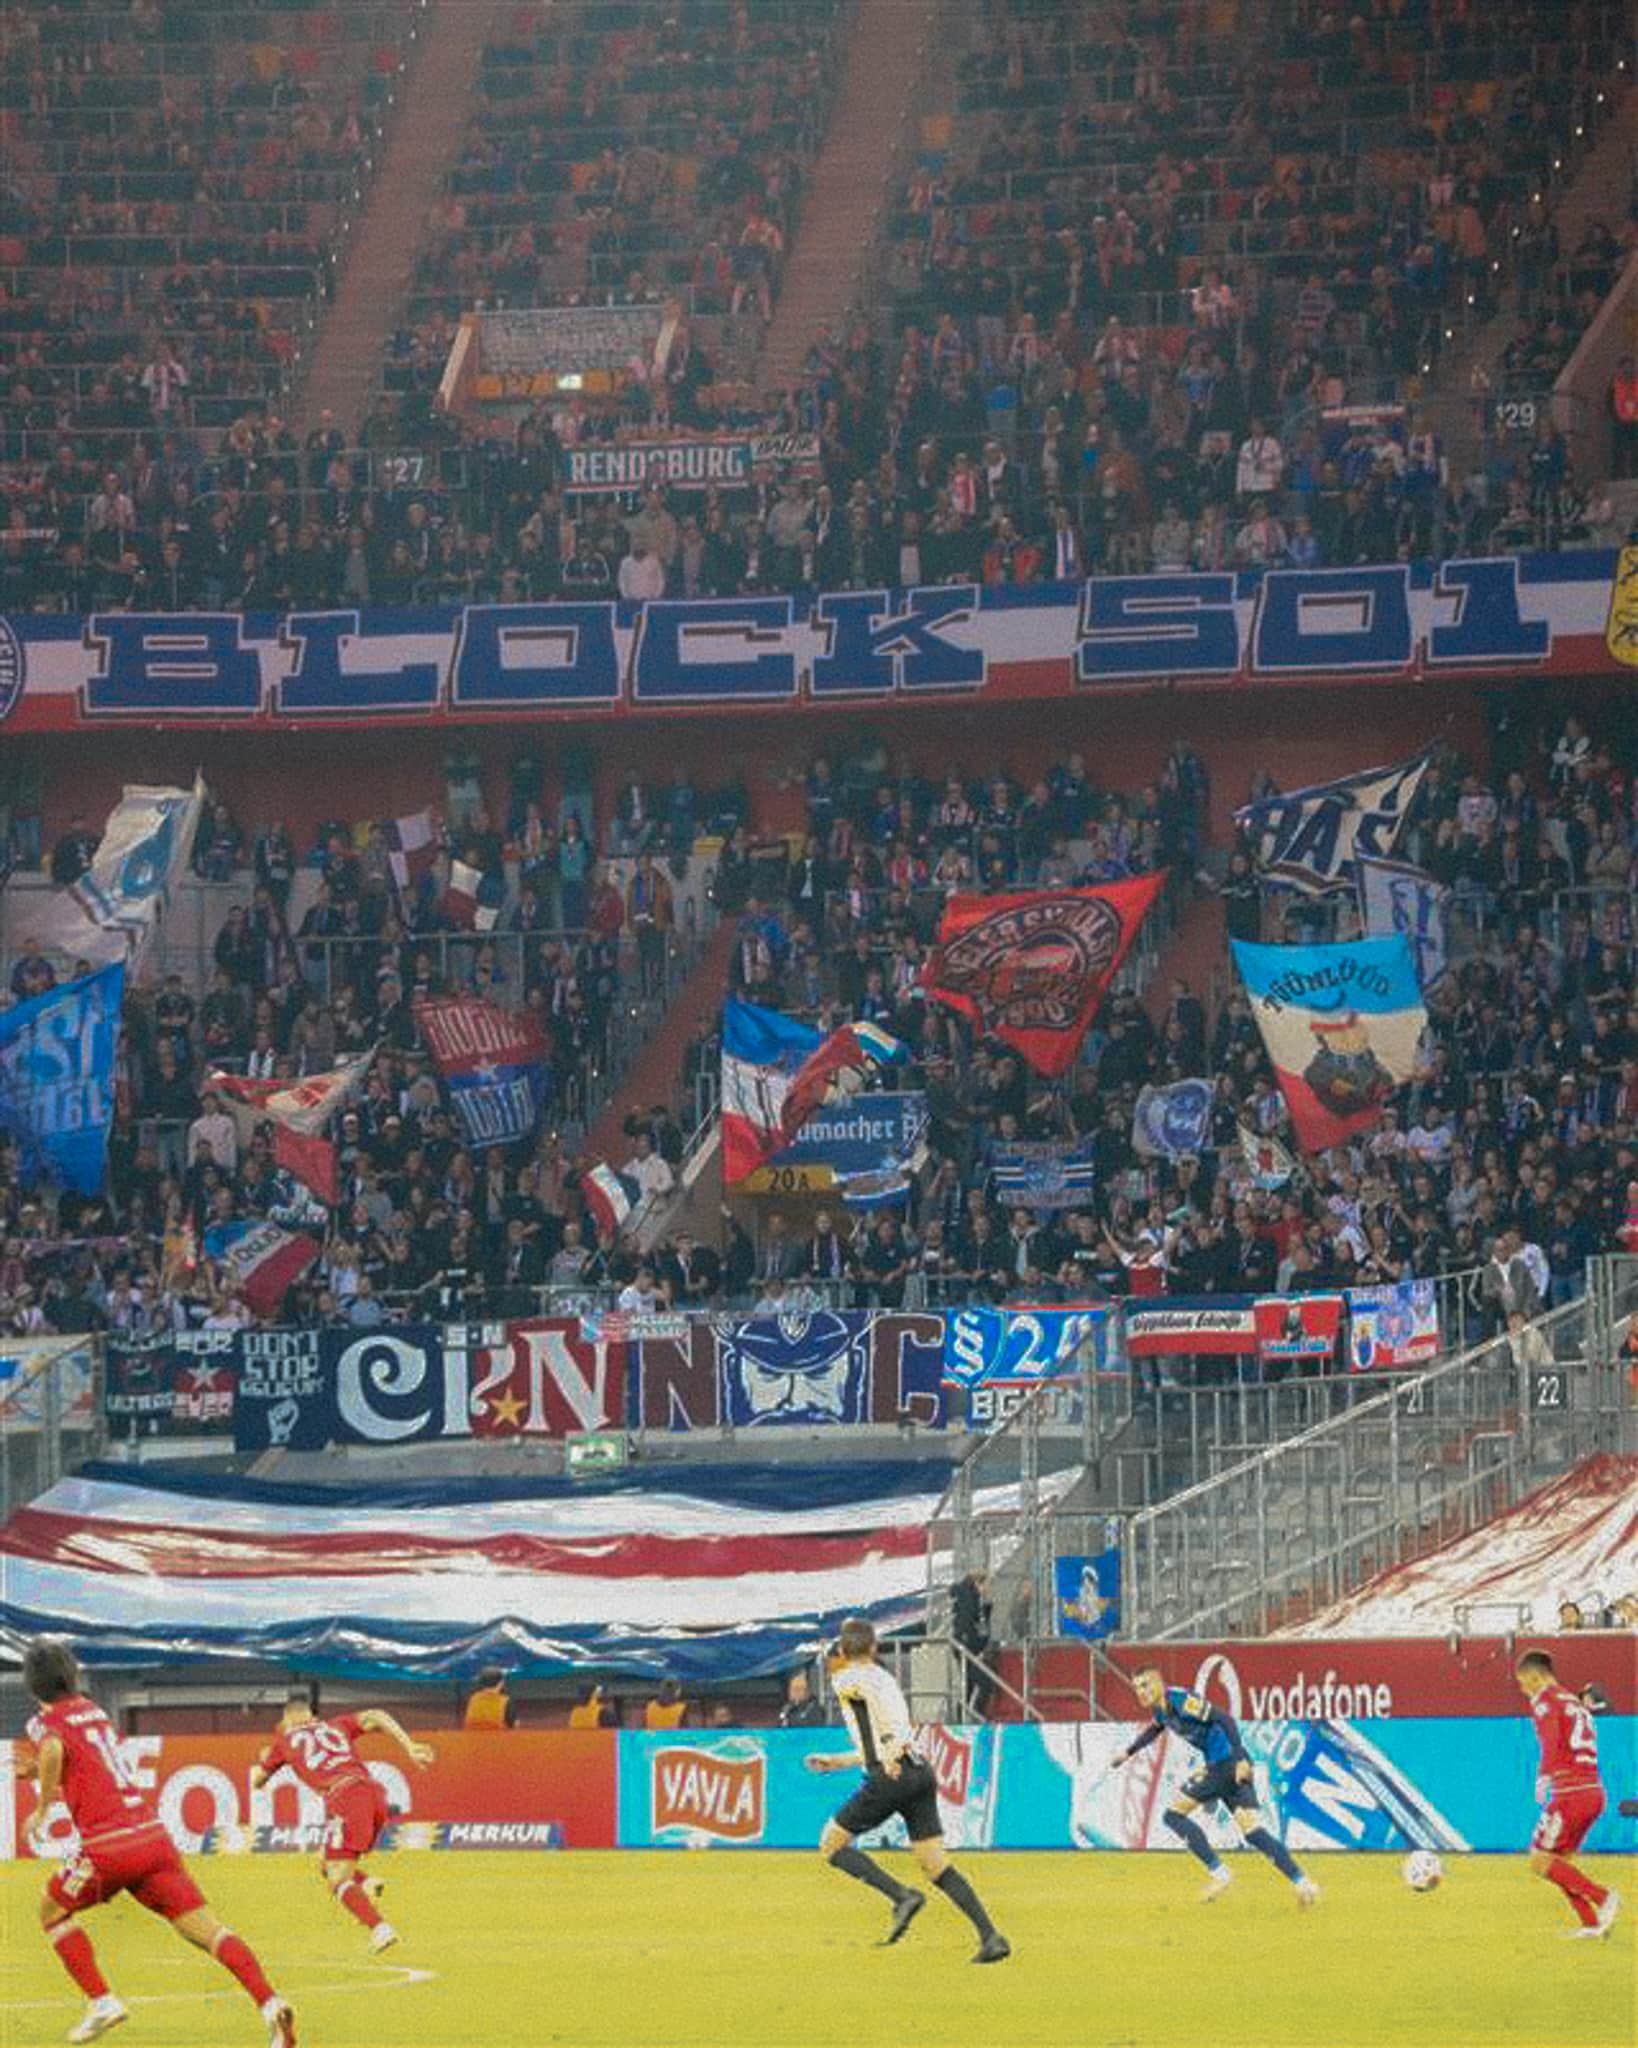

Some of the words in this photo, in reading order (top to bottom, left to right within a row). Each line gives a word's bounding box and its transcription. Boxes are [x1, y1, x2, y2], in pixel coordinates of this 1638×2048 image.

[80, 584, 987, 718] BLOCK
[244, 1354, 319, 1380] STOP
[1537, 1376, 1560, 1406] 22
[1249, 1670, 1393, 1720] vodafone
[449, 1823, 552, 1845] MERKUR
